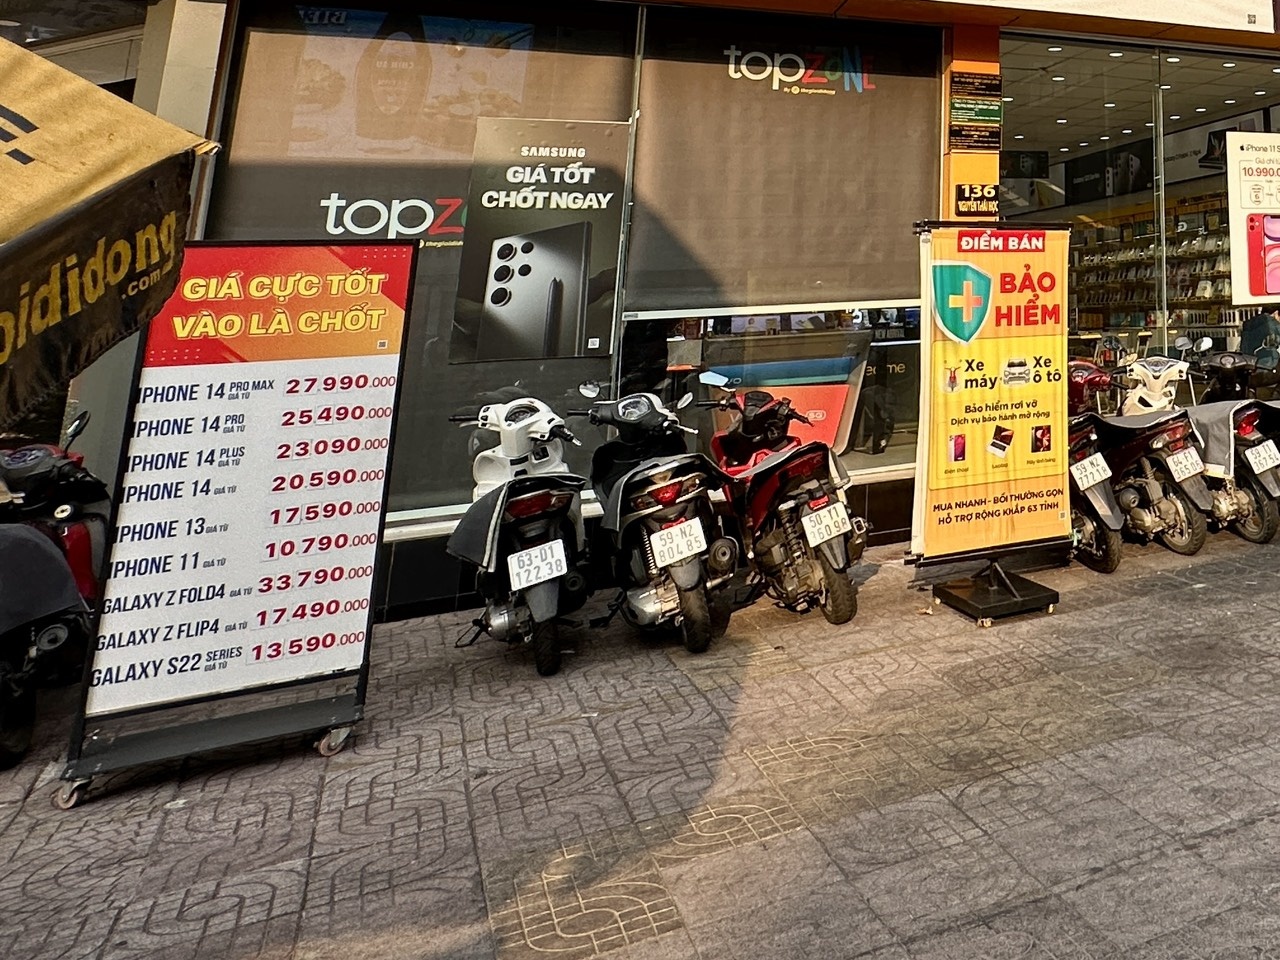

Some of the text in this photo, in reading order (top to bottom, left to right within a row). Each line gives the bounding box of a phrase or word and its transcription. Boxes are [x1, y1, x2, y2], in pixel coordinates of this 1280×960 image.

[521, 146, 586, 158] SAMSUNG
[1246, 144, 1268, 153] iPhone
[1269, 145, 1276, 153] 11
[506, 162, 596, 184] GIÁ TỐT
[481, 186, 614, 210] CHỐT NGAY
[962, 184, 996, 198] 136
[961, 230, 1043, 250] ĐIỂM BÁN
[121, 268, 162, 300] .com
[183, 267, 388, 302] GIÁ CỰC TỐT
[1000, 263, 1056, 293] BẢO
[173, 302, 388, 339] VÀO LÀ CHỐT
[995, 294, 1060, 327] HIỂM
[964, 356, 1052, 372] Xe Xe
[138, 375, 396, 404] IPHONE 14 PRO MAX 27.990.000
[964, 369, 1062, 390] máy ô tô
[951, 410, 1050, 426] Dịch vụ bảo hành mở rộng
[965, 400, 1038, 414] Bảo hiểm rơi vỡ
[133, 405, 392, 437] IPHONE 14 PRO 25.490.000
[126, 437, 388, 472] IPHONE 14 PLUS 23.090.000
[121, 469, 384, 503] IPHONE 14 20.590.000
[933, 503, 953, 512] MUA
[955, 498, 987, 509] NHANH
[1010, 489, 1044, 502] THƯỜNG
[1046, 488, 1064, 499] GỌN
[938, 513, 952, 525] HỖ
[955, 513, 973, 524] TRỢ
[975, 509, 1001, 521] RỘNG
[1003, 503, 1025, 516] KHẮP
[1027, 504, 1038, 513] 63
[109, 533, 376, 579] IPHONE 11 10.790.000
[102, 565, 372, 614] GALAXY Z FOLD4 33.790.000
[91, 632, 365, 687] GALAXY S22 SERIES 13.590.000
